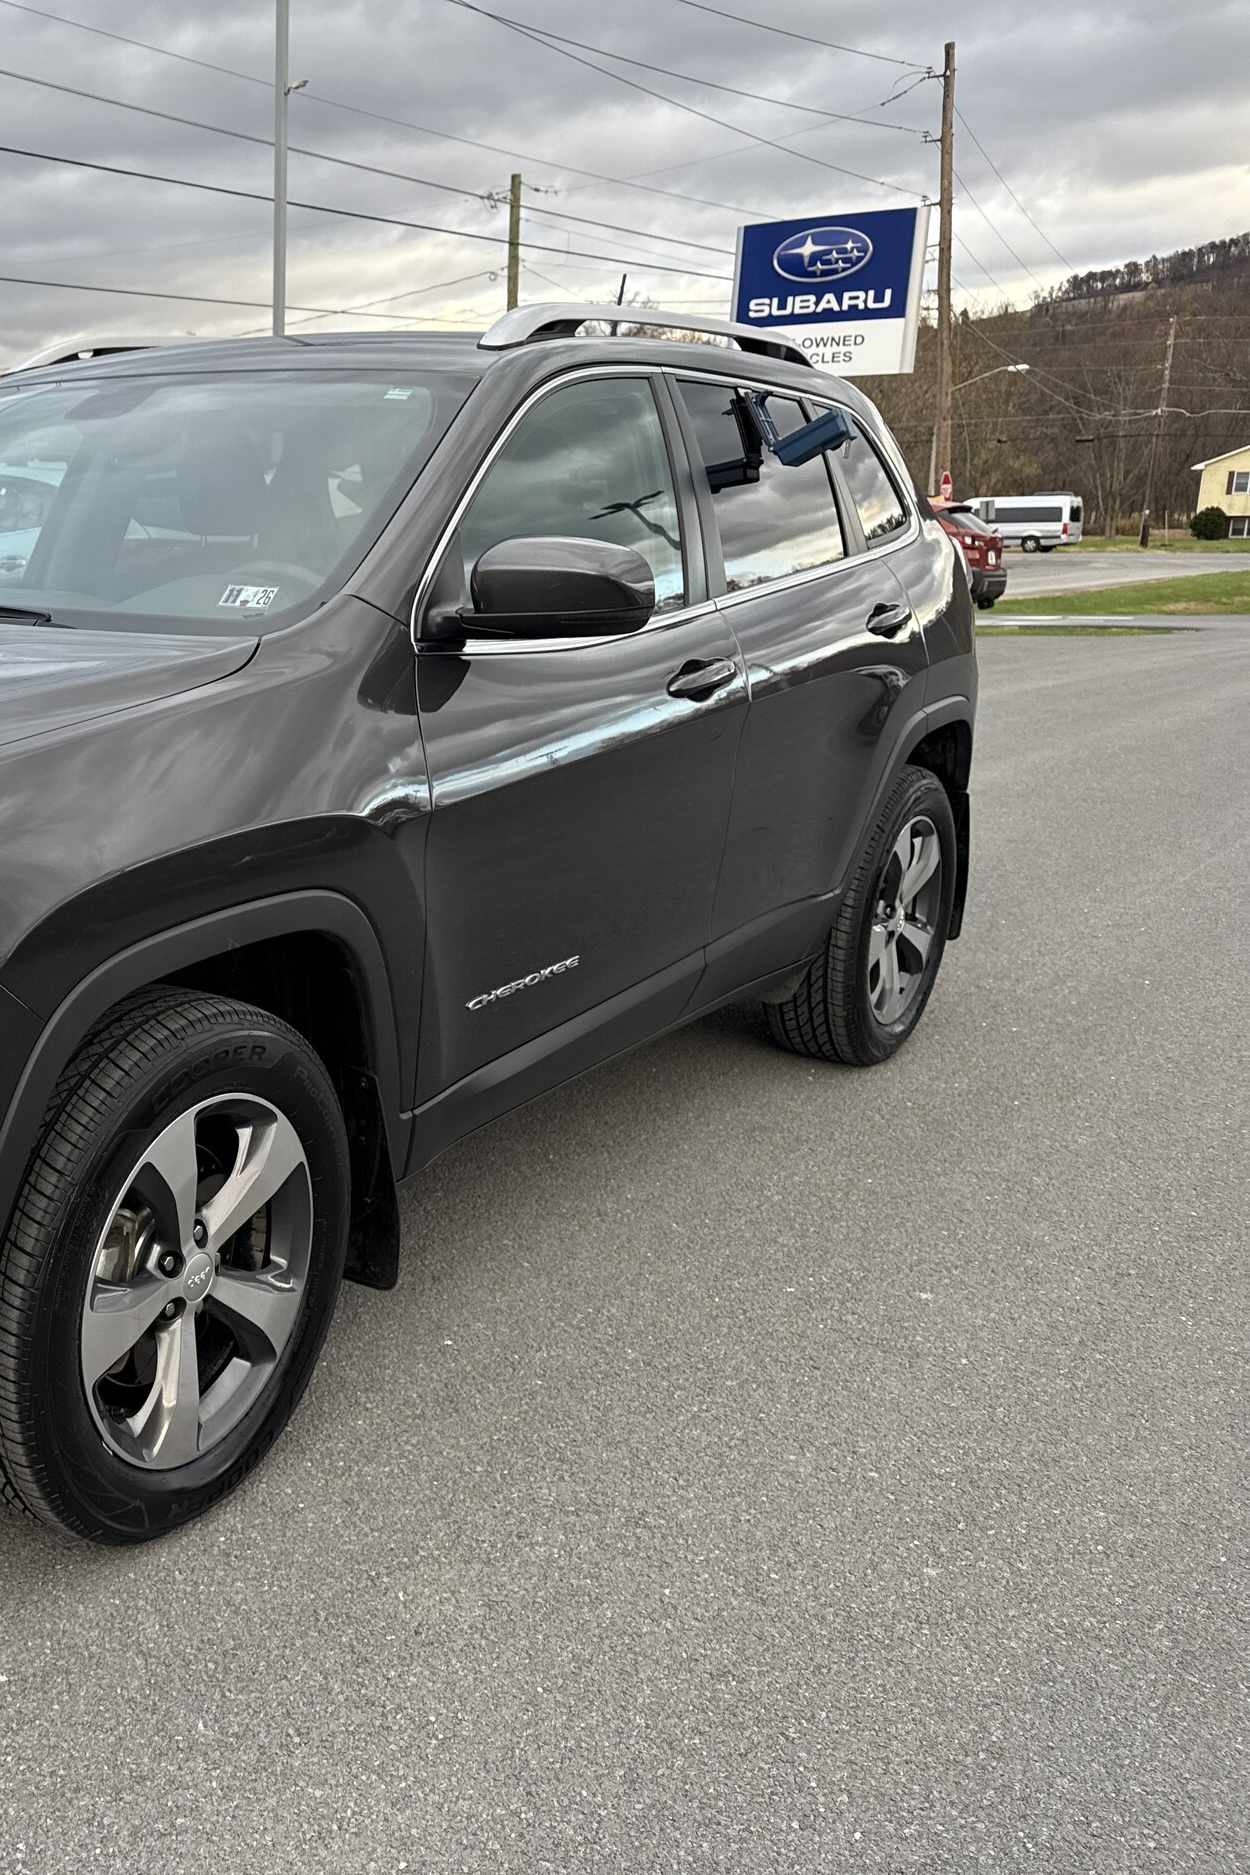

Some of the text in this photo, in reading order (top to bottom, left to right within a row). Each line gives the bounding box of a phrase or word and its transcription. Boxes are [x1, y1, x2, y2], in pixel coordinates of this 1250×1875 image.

[748, 288, 892, 318] SUBARU
[807, 350, 853, 365] CLES
[255, 588, 275, 606] 26
[465, 955, 580, 1011] CHEROKEE
[151, 1044, 267, 1115] COOPER
